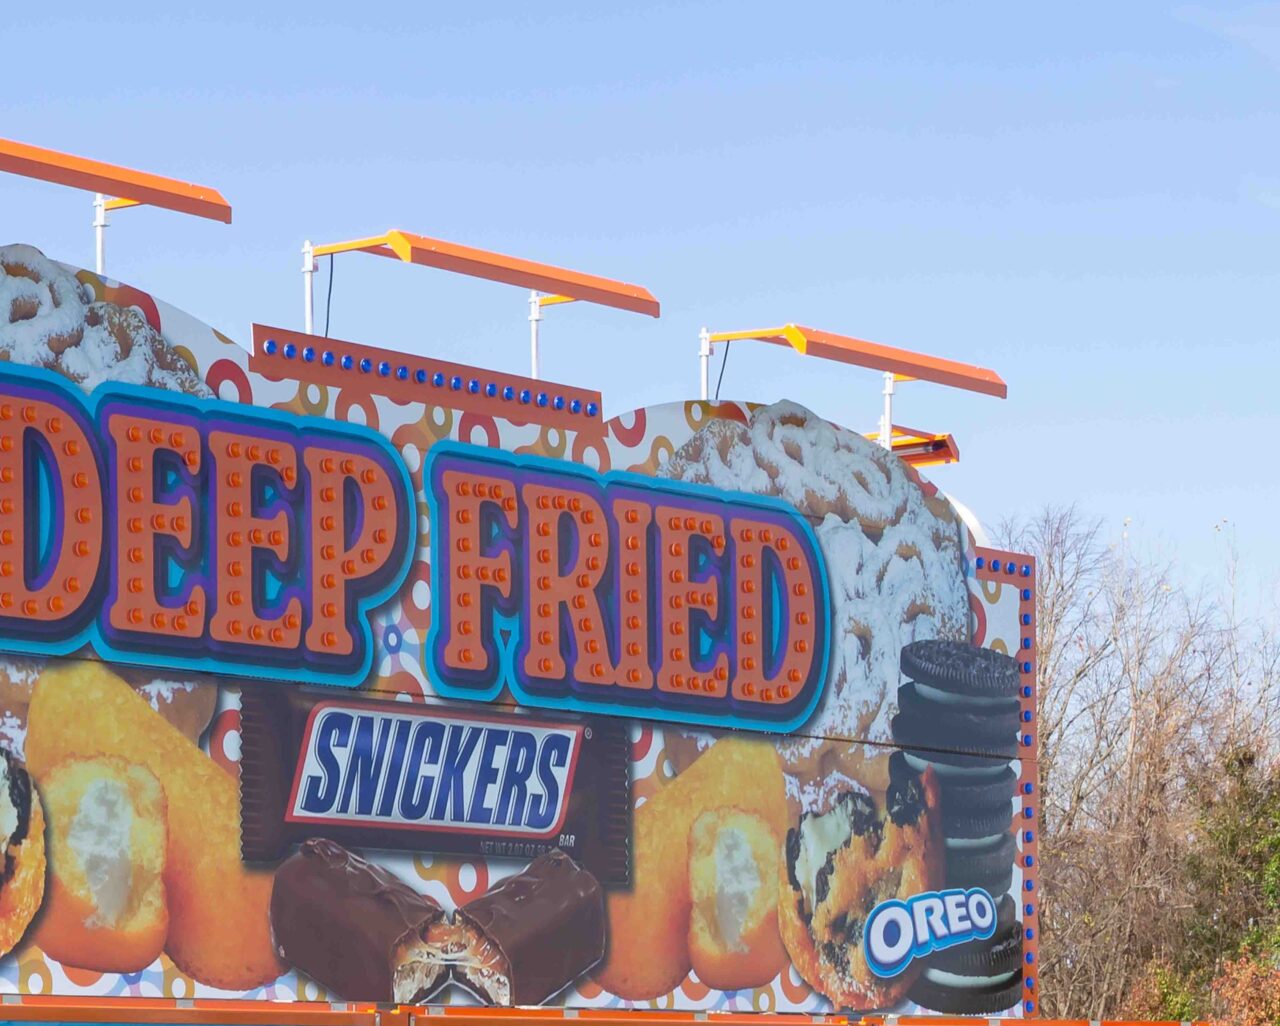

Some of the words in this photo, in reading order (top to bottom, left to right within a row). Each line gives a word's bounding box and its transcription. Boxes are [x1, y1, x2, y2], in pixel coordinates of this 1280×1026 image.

[443, 470, 816, 704] FRIED
[300, 711, 571, 830] SNICKERS
[559, 834, 576, 847] BAR
[870, 890, 994, 970] OREO
